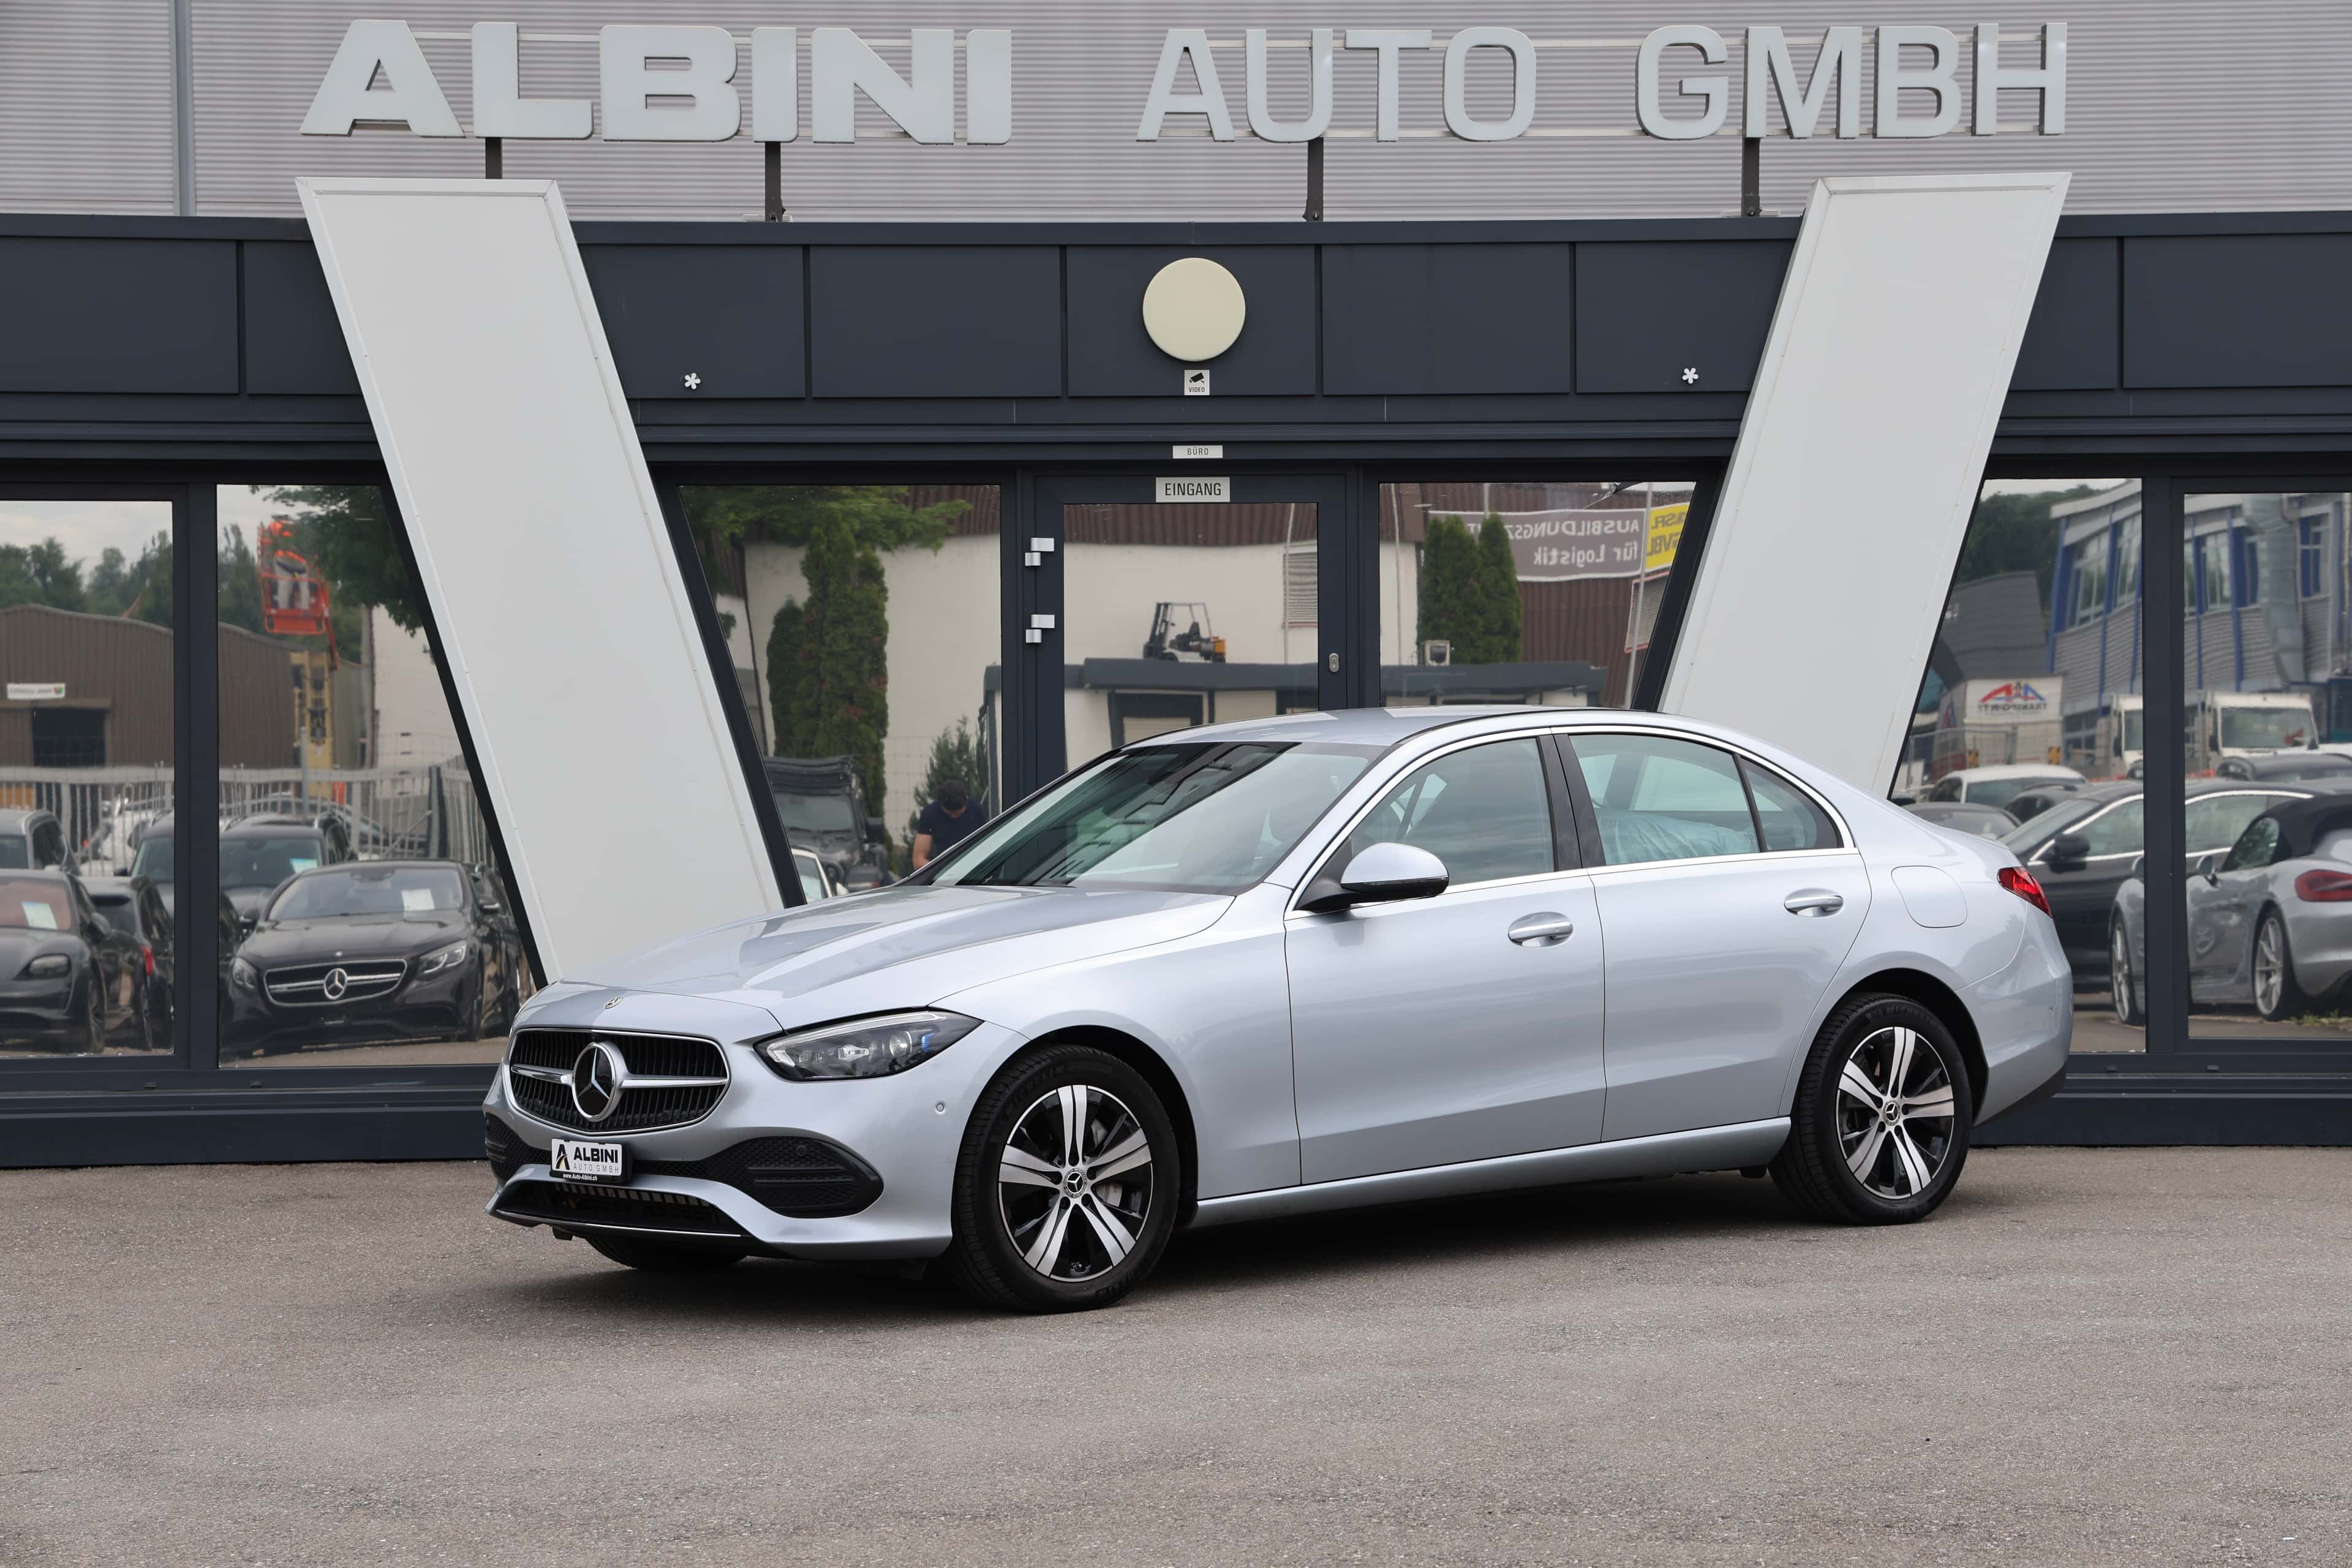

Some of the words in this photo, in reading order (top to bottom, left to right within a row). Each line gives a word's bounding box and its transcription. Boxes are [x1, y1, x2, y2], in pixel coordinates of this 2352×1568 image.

[300, 19, 1012, 146] ALBINI
[1136, 26, 1537, 143] AUTO
[1636, 23, 2068, 140] GMBH
[1187, 447, 1208, 456] BÜRO
[1165, 483, 1221, 496] EINGANG
[574, 1147, 618, 1163] ALBINI
[597, 1164, 619, 1173] GMBH
